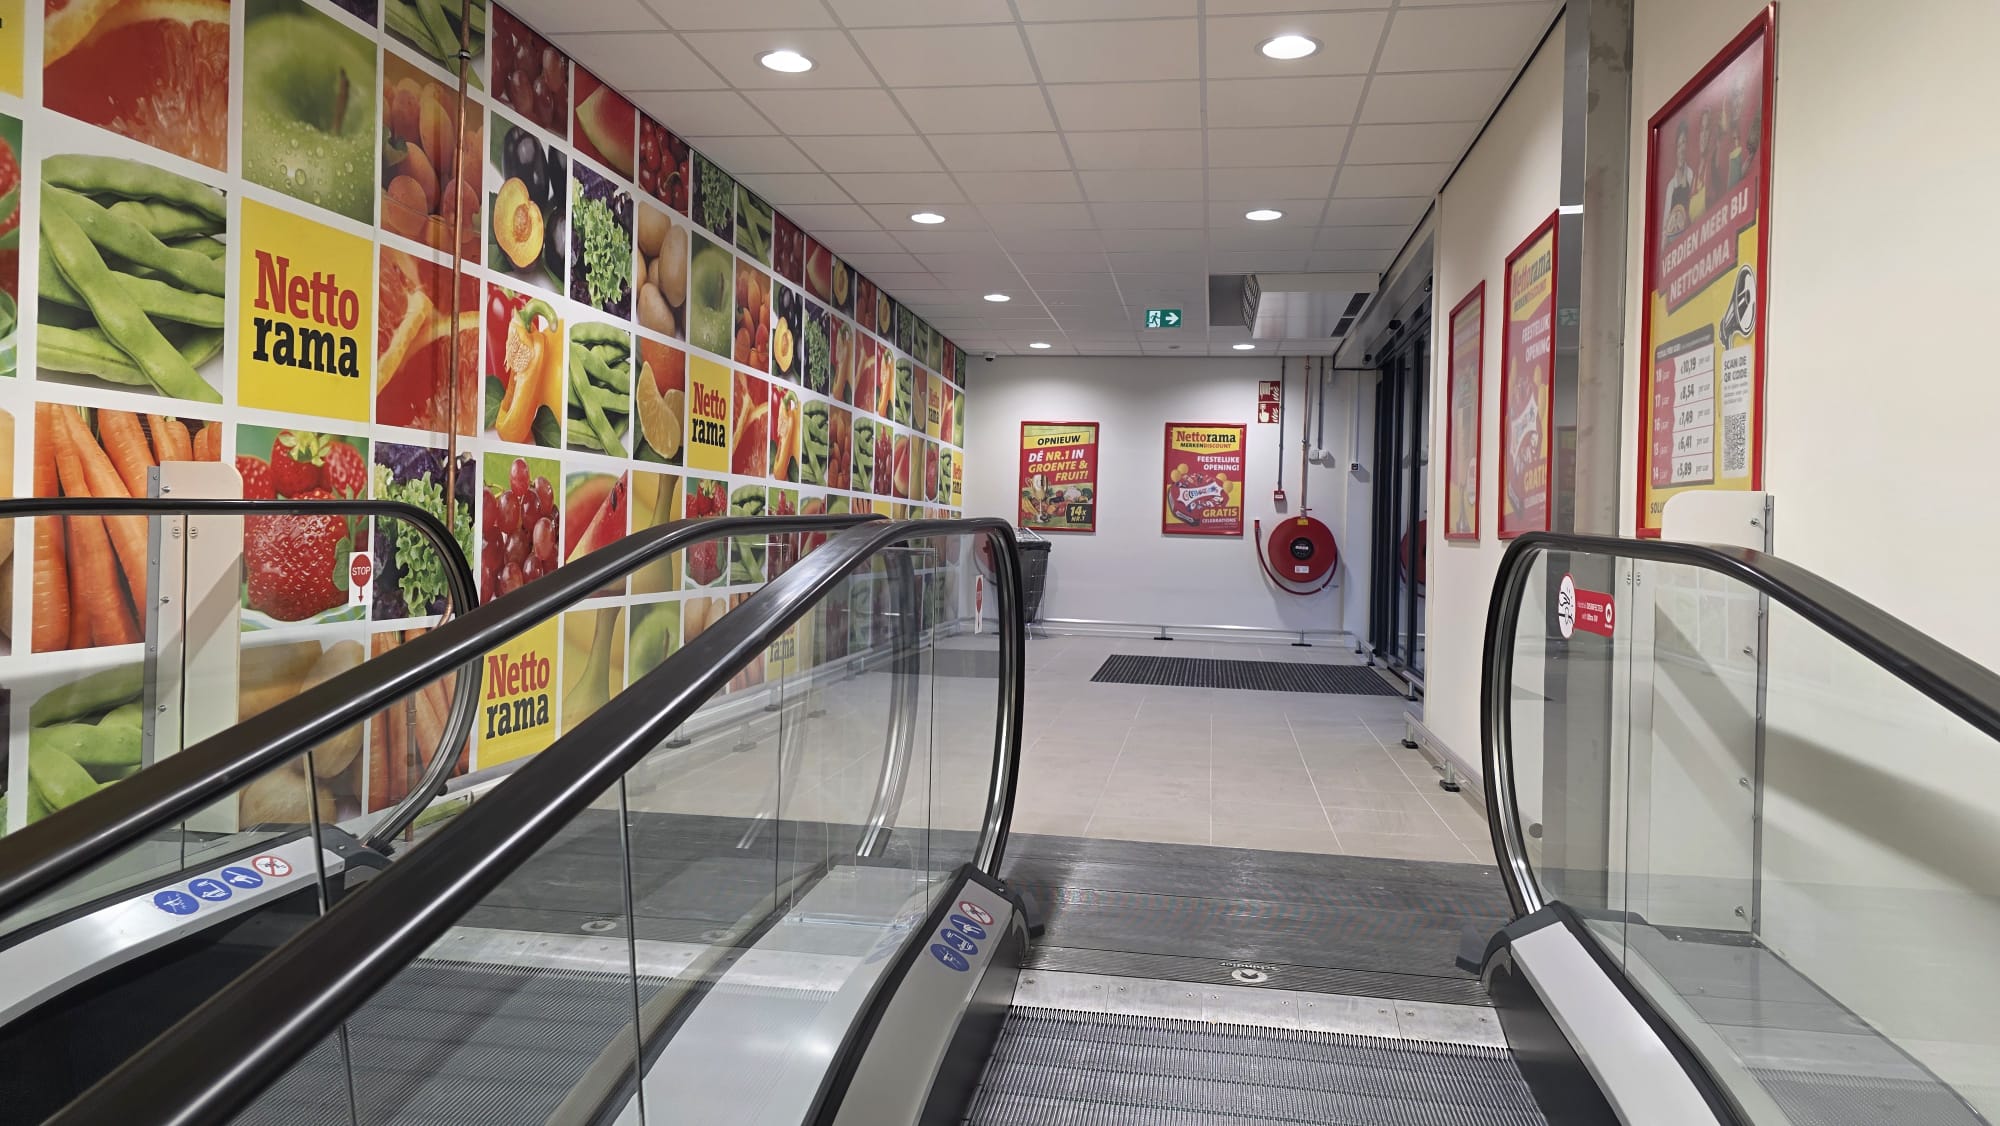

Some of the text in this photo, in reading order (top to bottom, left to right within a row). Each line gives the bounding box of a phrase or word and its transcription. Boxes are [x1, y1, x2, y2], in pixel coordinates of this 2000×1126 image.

[1662, 187, 1748, 277] VERDIEN MEER BIJ
[1669, 238, 1730, 302] NETTORAMA
[254, 249, 359, 331] Netto
[1522, 313, 1550, 344] FEESTELIJK
[253, 317, 359, 378] rama
[1724, 359, 1737, 371] SCAN
[1739, 356, 1747, 366] DE
[1724, 368, 1747, 383] QR CODE
[692, 381, 727, 421] Netto
[691, 418, 726, 448] rama
[1037, 434, 1081, 446] OPNIEUW
[1175, 430, 1236, 443] Nettorama
[1028, 448, 1084, 463] DÉ NR.1 IN
[1197, 455, 1240, 464] FEESTELIJKE
[1028, 460, 1088, 473] GROENTE &
[1203, 463, 1240, 472] OPENING!
[1055, 470, 1089, 482] FRUIT!
[1202, 508, 1238, 518] GRATIS
[352, 566, 371, 576] STOP
[769, 637, 795, 664] rama
[487, 650, 550, 701] Netto
[486, 693, 550, 740] rama
